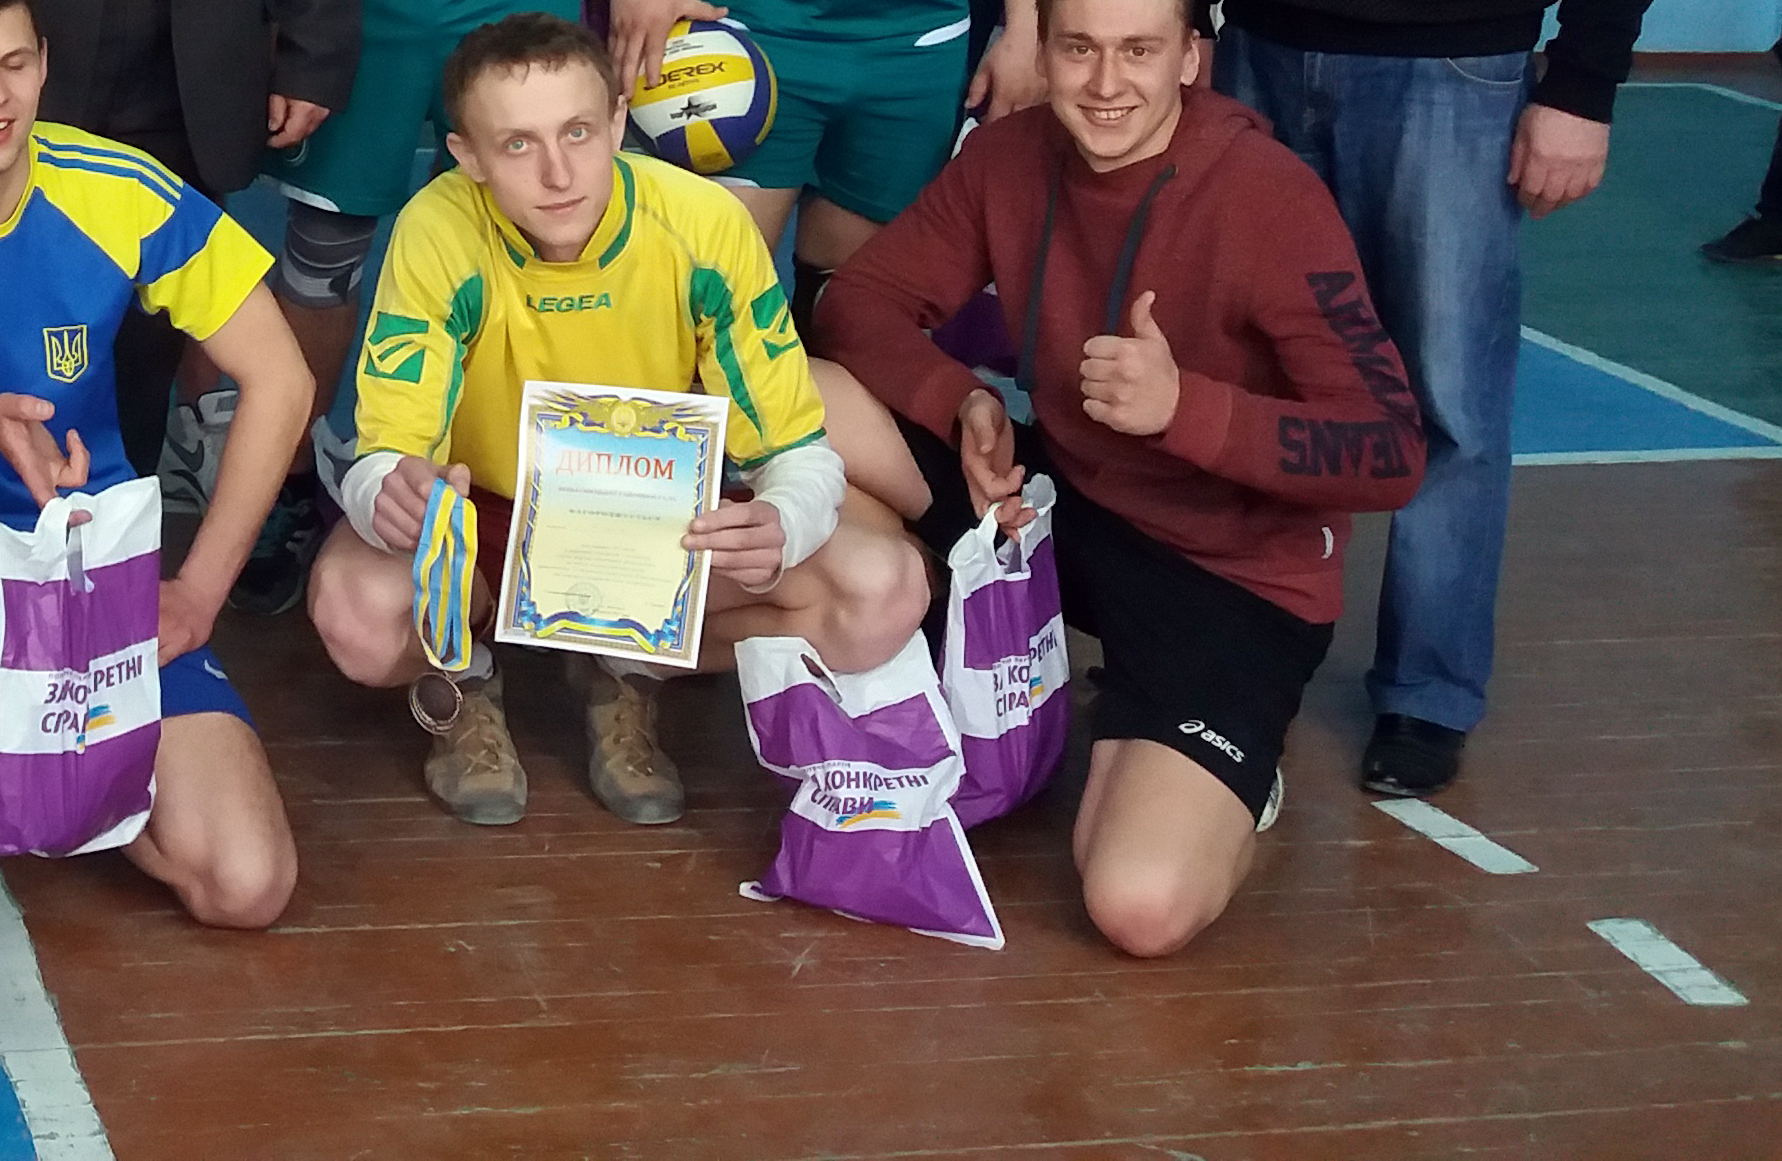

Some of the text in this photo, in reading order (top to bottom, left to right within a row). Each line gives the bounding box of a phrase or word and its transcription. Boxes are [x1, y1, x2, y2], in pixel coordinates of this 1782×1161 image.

[526, 292, 612, 313] LEGEA
[555, 449, 676, 481] ДИПЛОМ
[1200, 729, 1245, 763] asics
